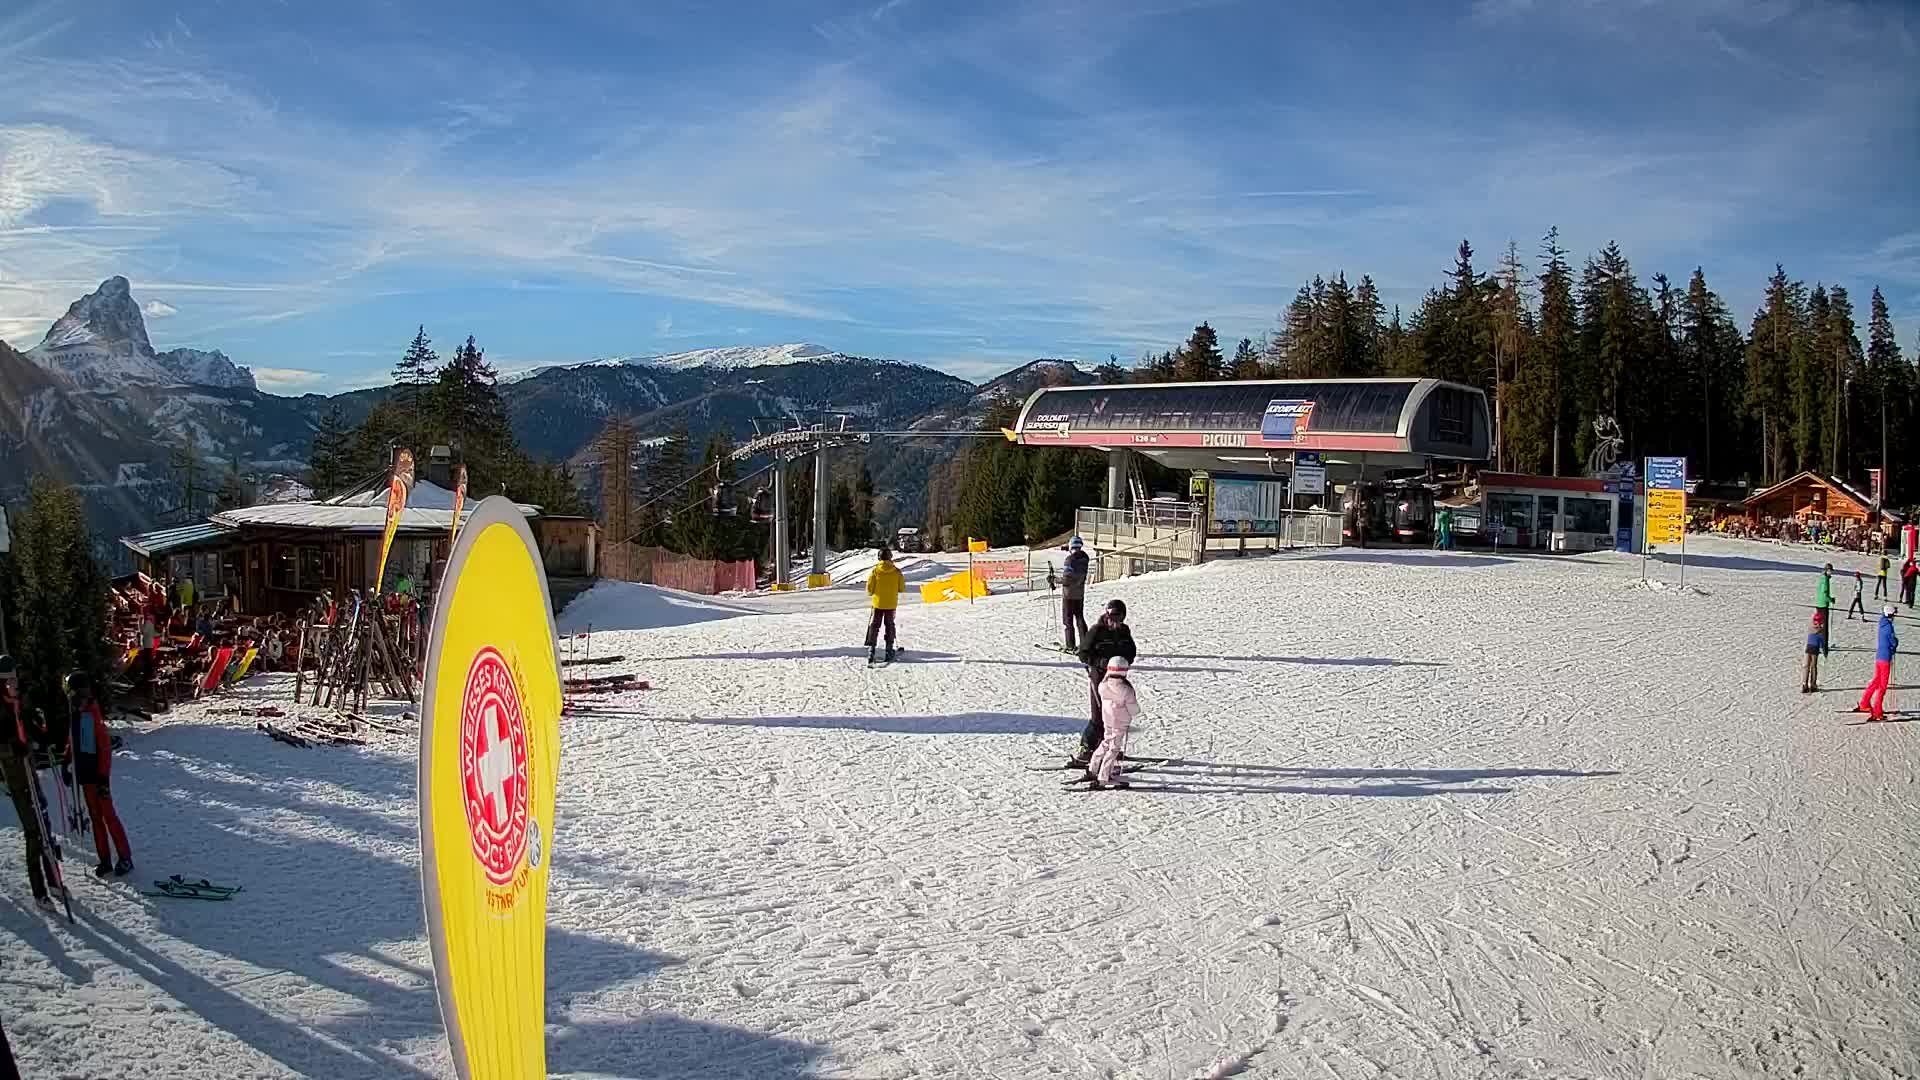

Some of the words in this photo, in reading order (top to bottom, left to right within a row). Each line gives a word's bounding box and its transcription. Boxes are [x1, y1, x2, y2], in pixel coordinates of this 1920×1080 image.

[1036, 414, 1069, 422] DOLOMITI
[1202, 433, 1246, 447] PICULIN
[465, 664, 492, 777] WEISSES
[493, 664, 521, 741] KREUZ
